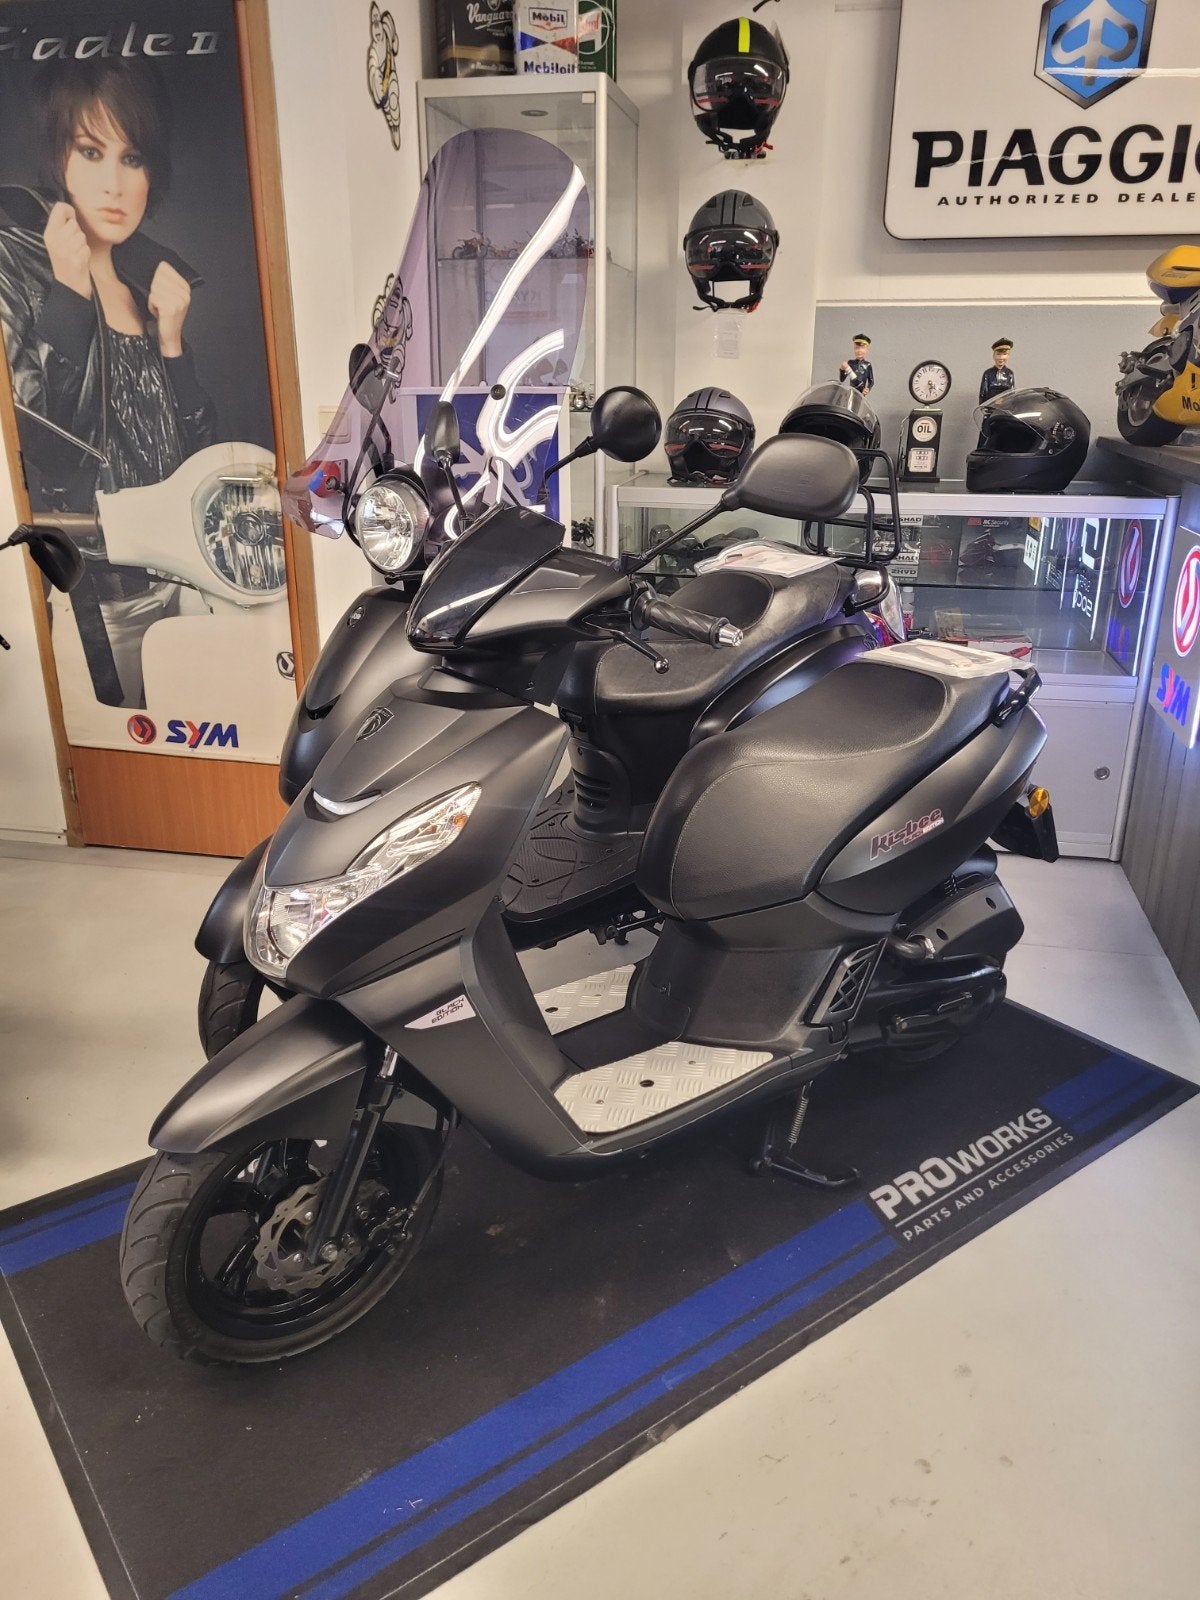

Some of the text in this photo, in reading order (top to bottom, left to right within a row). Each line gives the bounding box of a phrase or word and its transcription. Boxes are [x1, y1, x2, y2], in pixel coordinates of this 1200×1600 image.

[532, 11, 565, 24] Mobil
[523, 60, 575, 75] Mobiloil
[912, 123, 1200, 188] PIAGGI
[937, 193, 1099, 206] AUTHORIZED
[916, 425, 932, 434] OIL
[1156, 662, 1191, 727] SYM
[165, 719, 239, 748] SYM
[870, 808, 942, 861] Kisbee
[431, 1003, 464, 1024] EDITION
[869, 1107, 1053, 1220] PROWORKS
[903, 1132, 1074, 1241] PARTS AND ACCESSORIES
